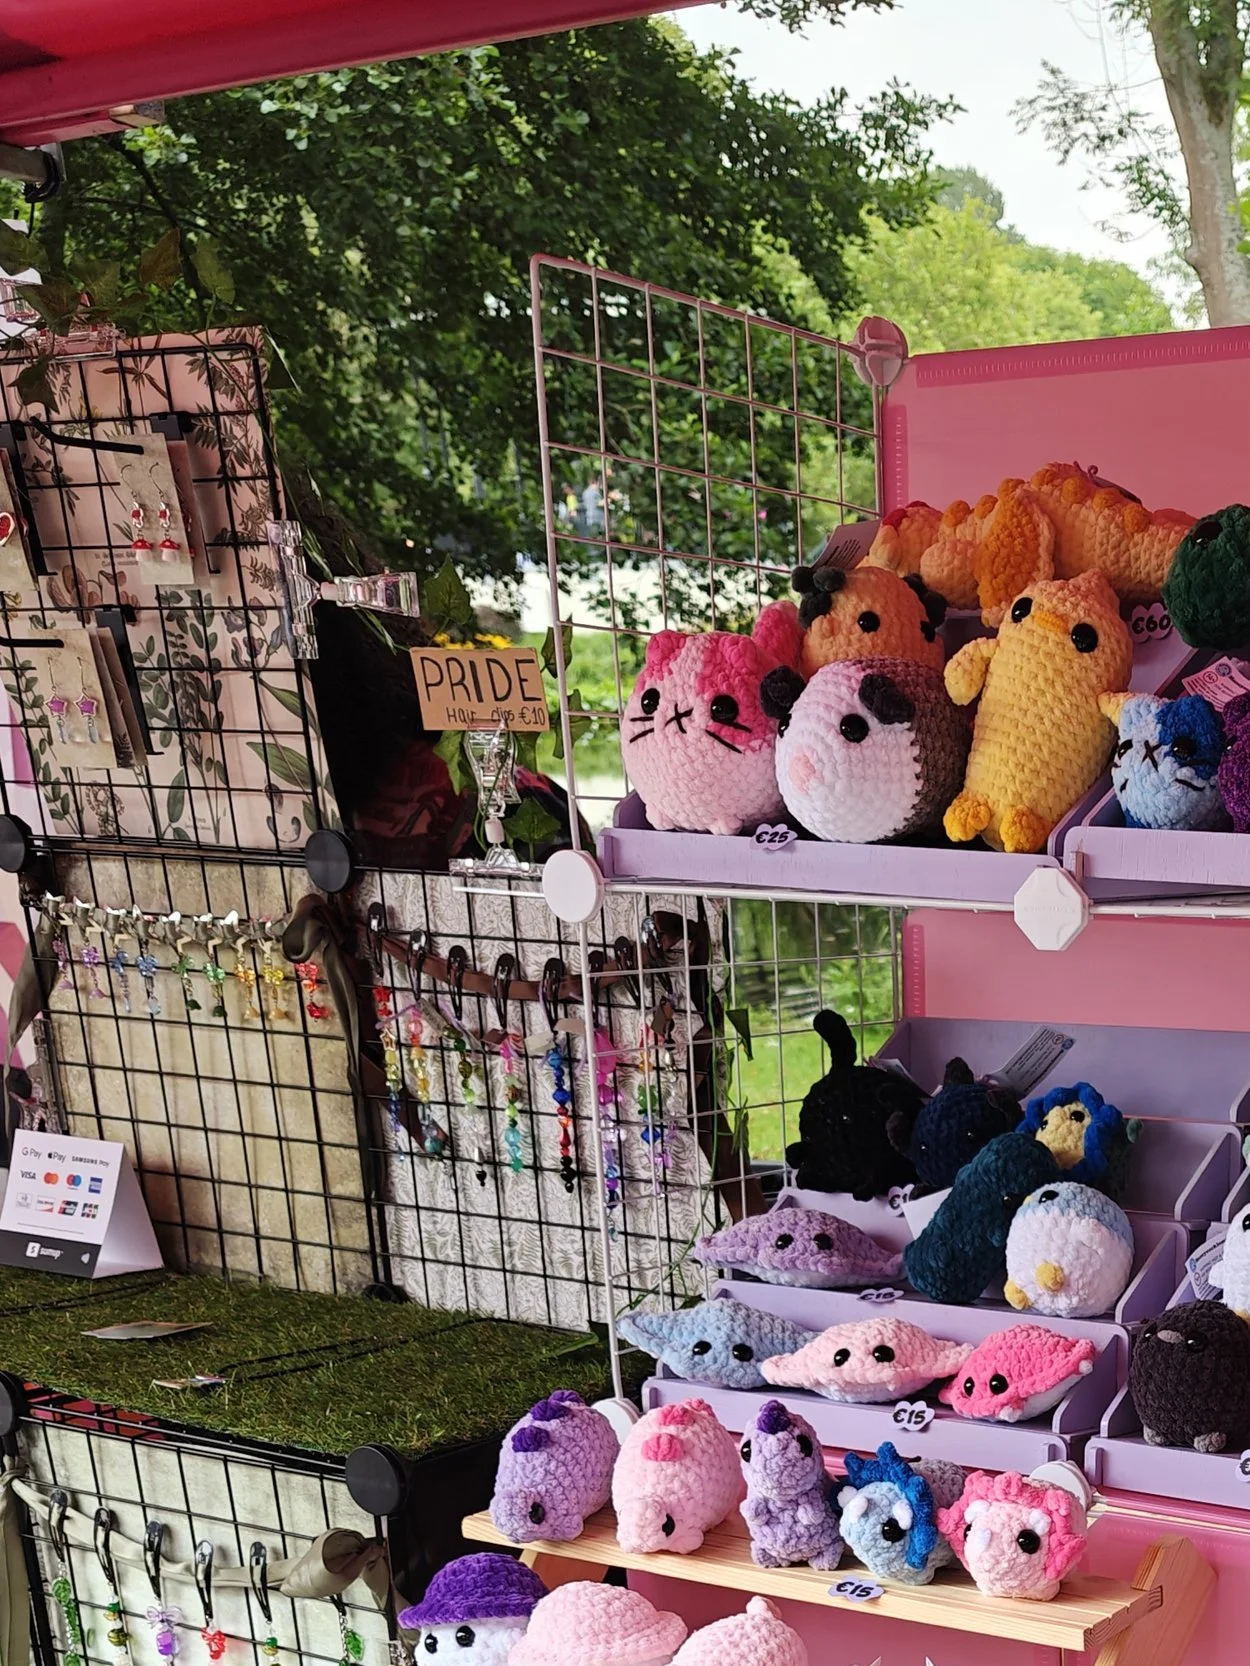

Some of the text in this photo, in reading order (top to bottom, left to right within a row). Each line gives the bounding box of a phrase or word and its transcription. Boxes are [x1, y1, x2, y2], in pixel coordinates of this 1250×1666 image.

[1131, 615, 1171, 635] €60
[420, 656, 542, 703] PRIDE
[446, 706, 477, 724] Hair
[518, 706, 546, 726] €10
[755, 830, 790, 844] €25
[20, 1170, 36, 1180] VISA
[888, 1193, 908, 1210] €1
[892, 1408, 926, 1425] €15
[836, 1581, 874, 1598] €15
